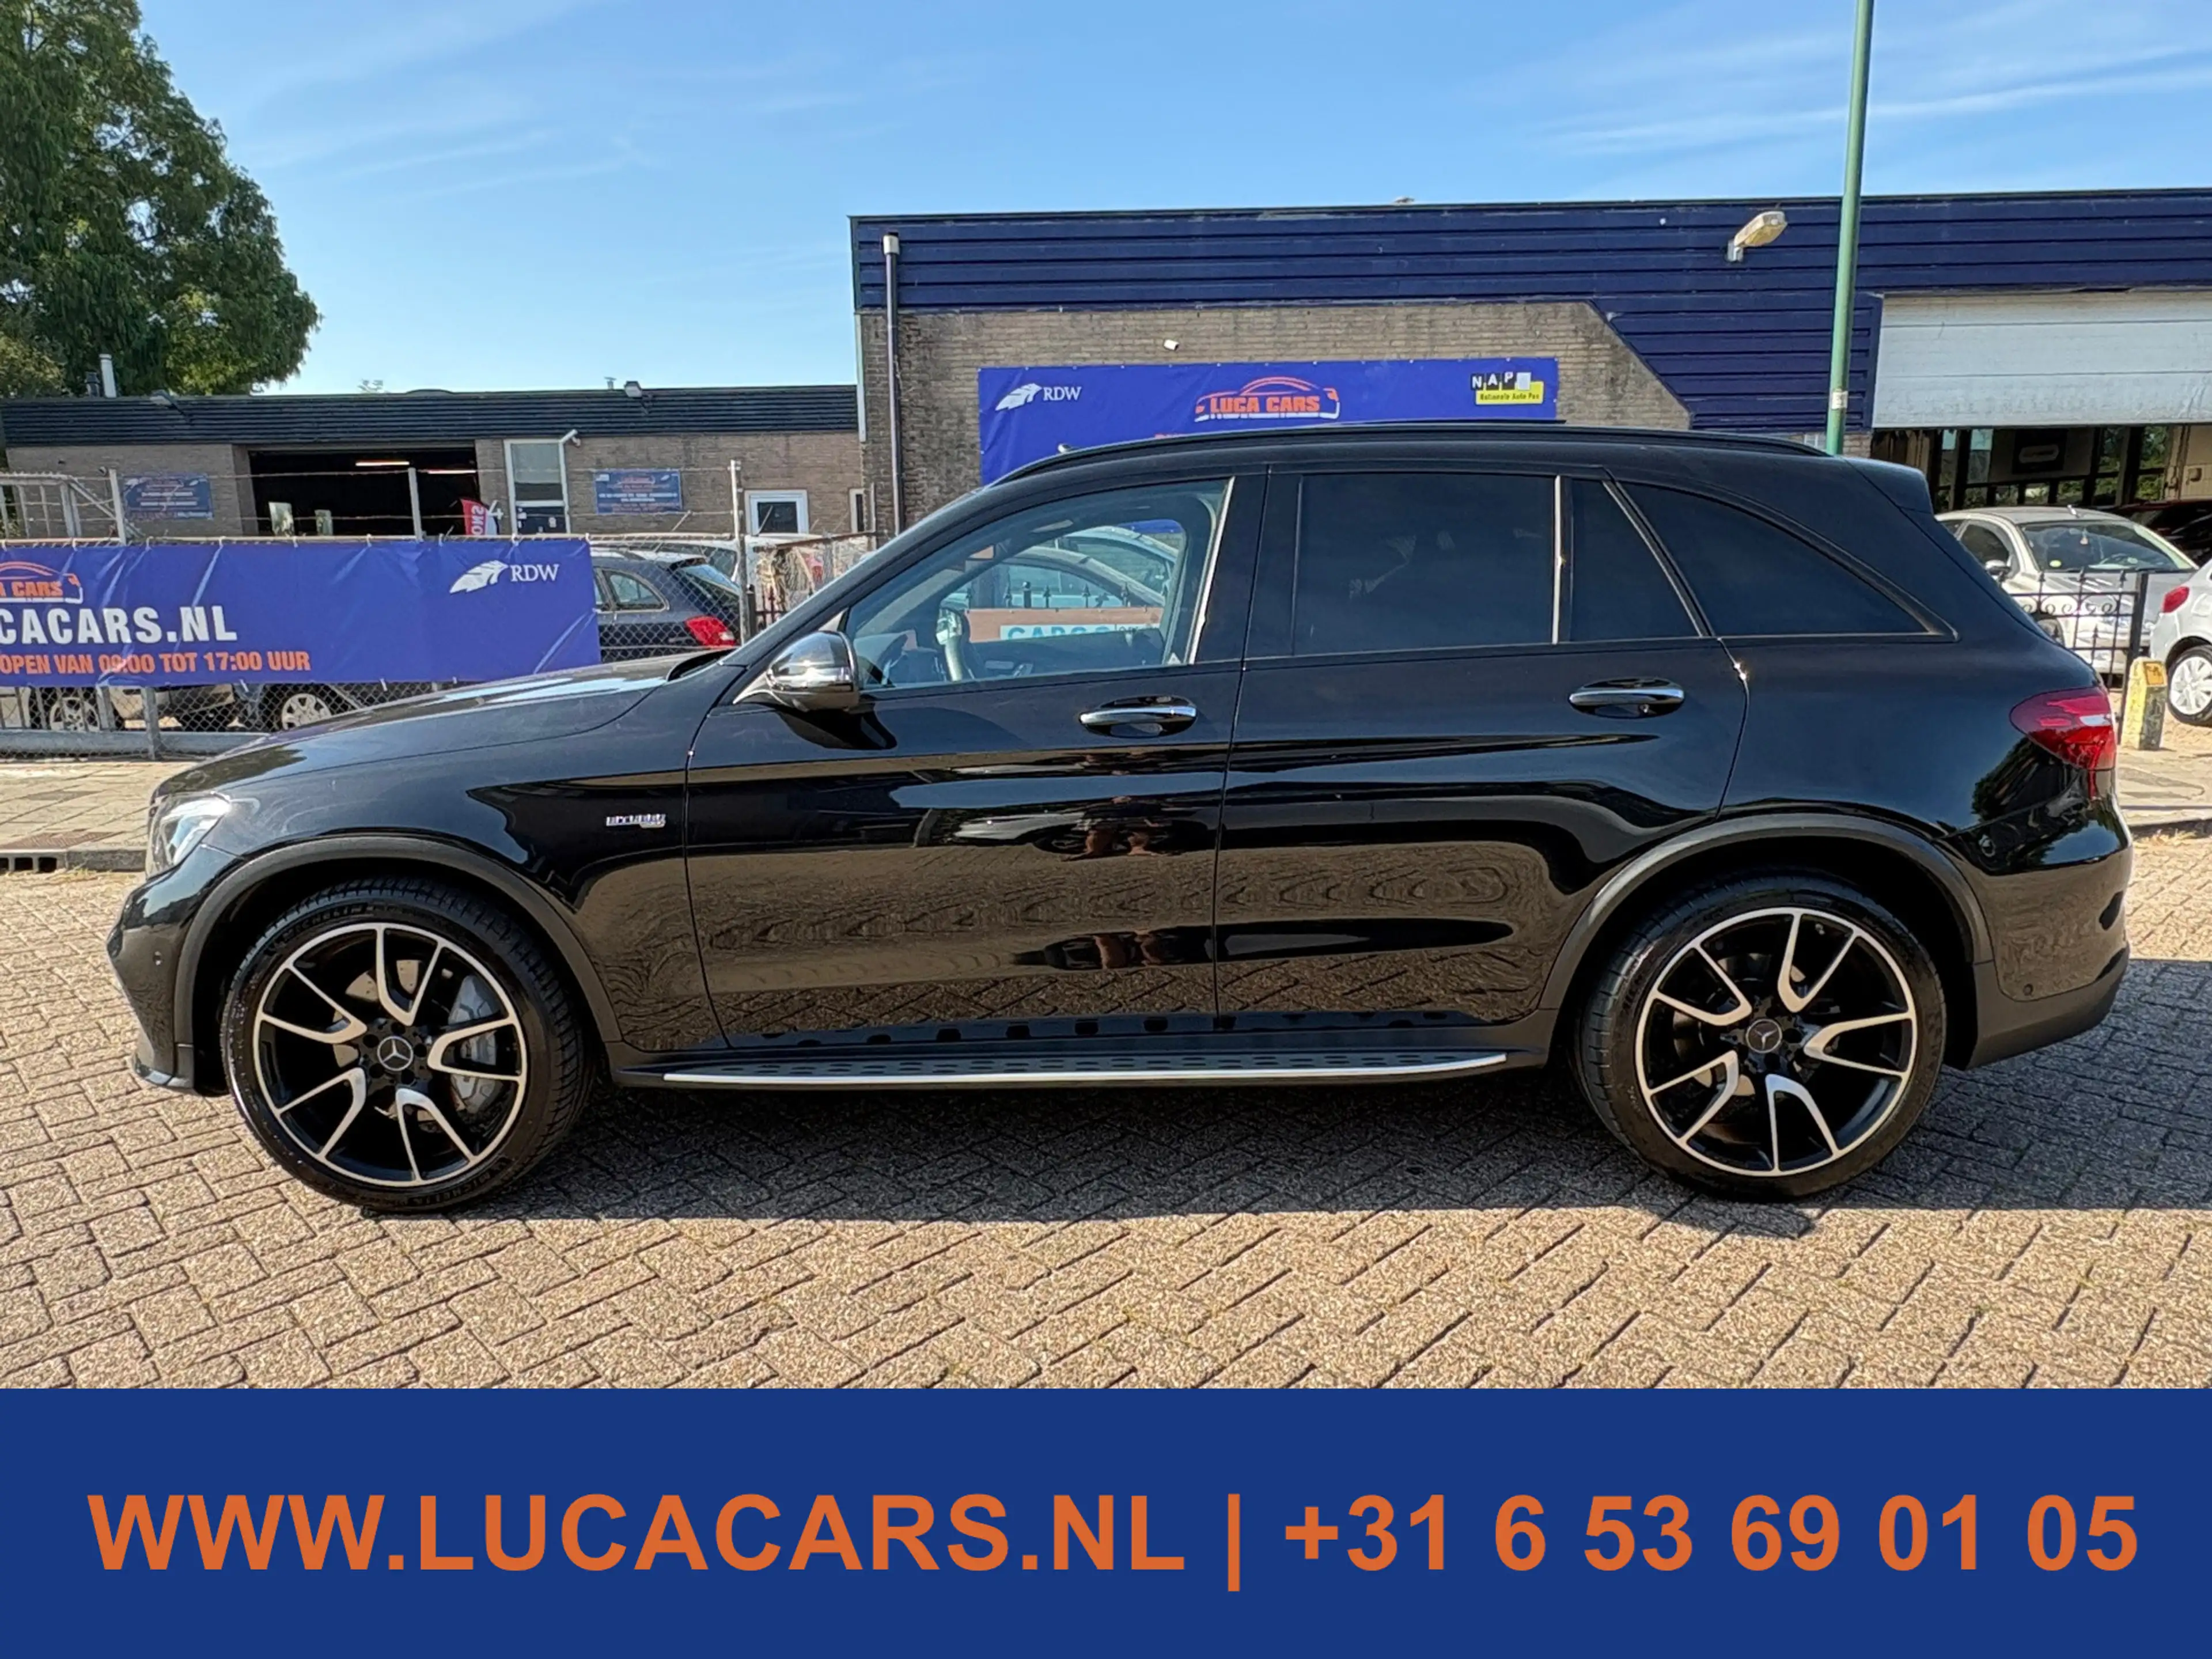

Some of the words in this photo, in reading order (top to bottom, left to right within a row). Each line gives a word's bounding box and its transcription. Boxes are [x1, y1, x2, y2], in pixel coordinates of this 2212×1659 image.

[1472, 372, 1514, 389] NAP
[1043, 386, 1082, 402] RDW
[1210, 396, 1260, 414] LUCA
[1266, 396, 1320, 413] CARS
[509, 563, 560, 582] RDW
[11, 581, 63, 597] CARS
[0, 653, 52, 675] OPEN
[54, 653, 94, 674] VAN
[158, 652, 198, 673] TOT
[203, 651, 263, 672] 17:00
[267, 650, 312, 672] UUR
